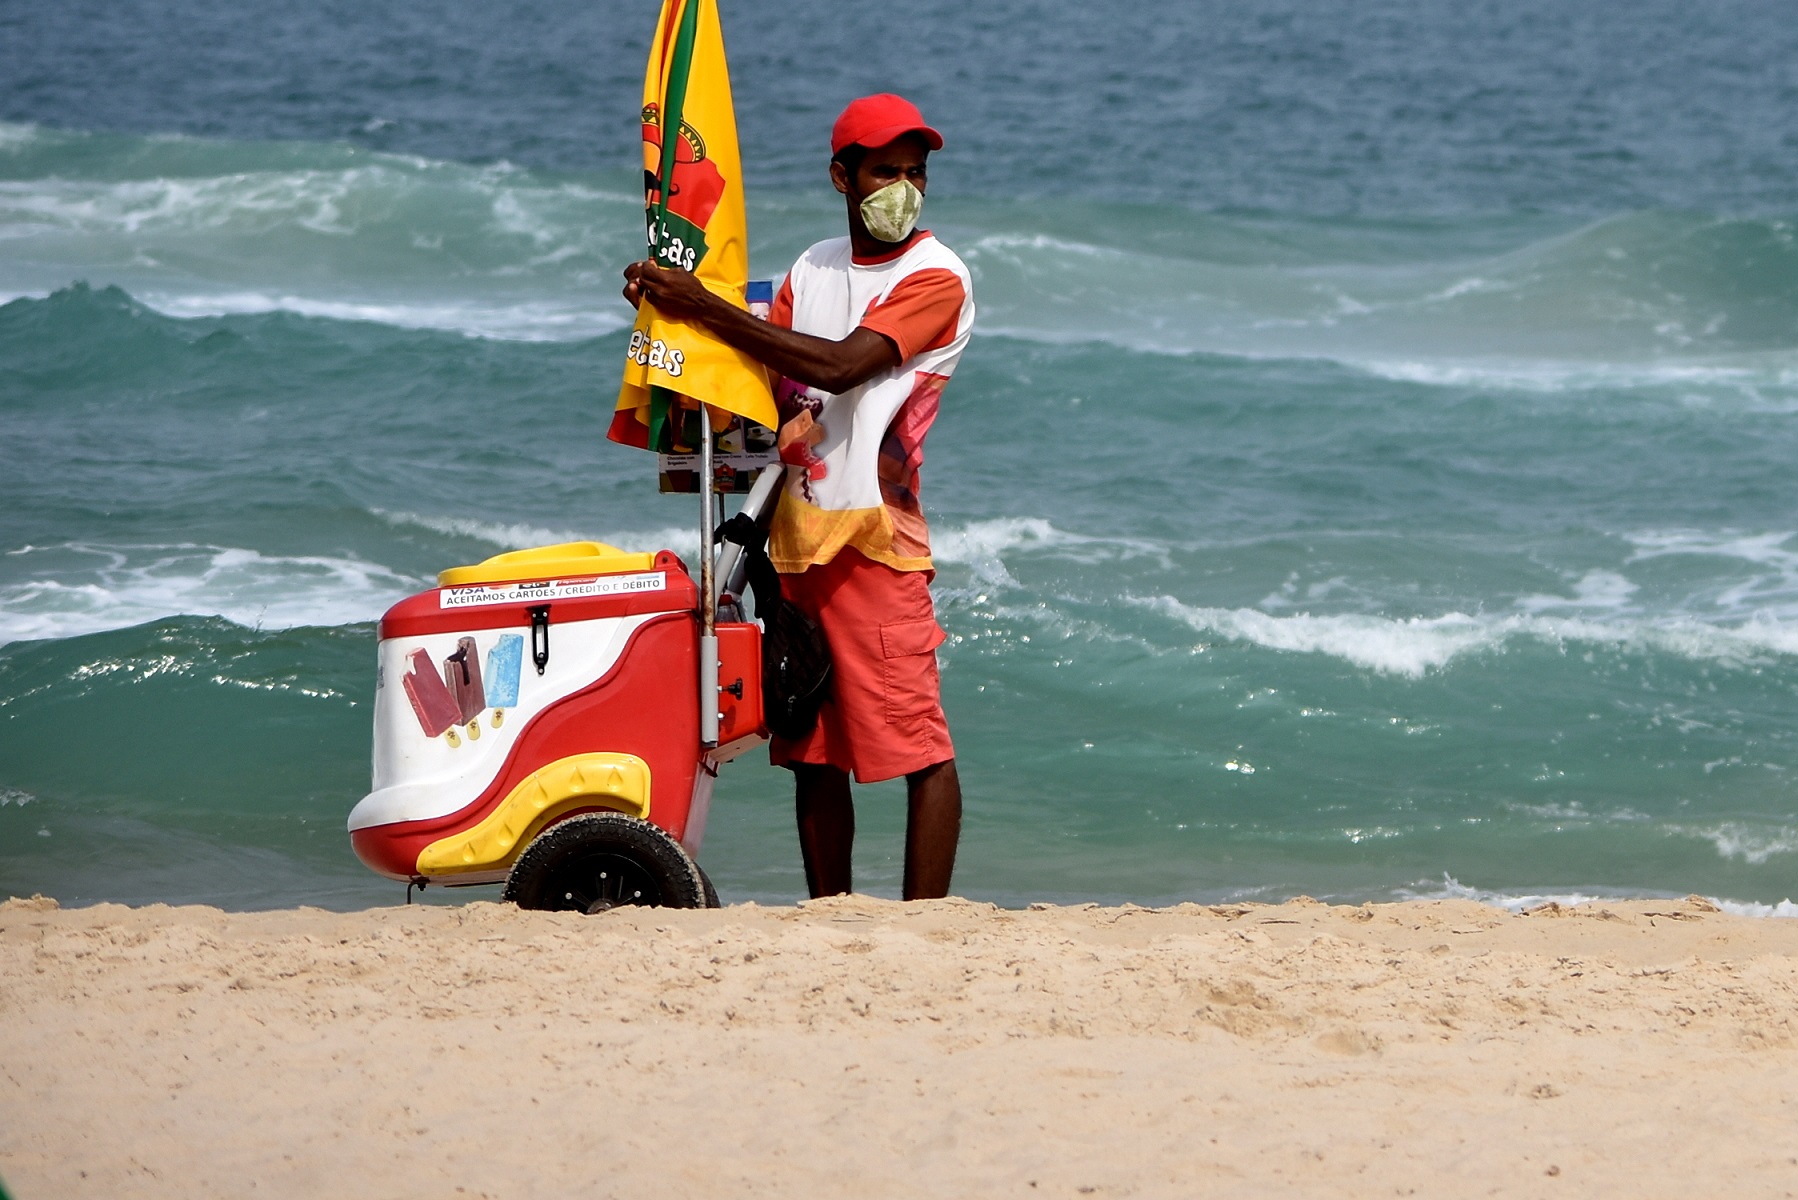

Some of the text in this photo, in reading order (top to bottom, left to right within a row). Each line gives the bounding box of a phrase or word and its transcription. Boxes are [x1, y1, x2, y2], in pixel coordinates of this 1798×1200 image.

[627, 325, 685, 377] etas
[446, 579, 660, 605] ACEITAMOS CARTÕES / CRÉDITO E DÉBITO
